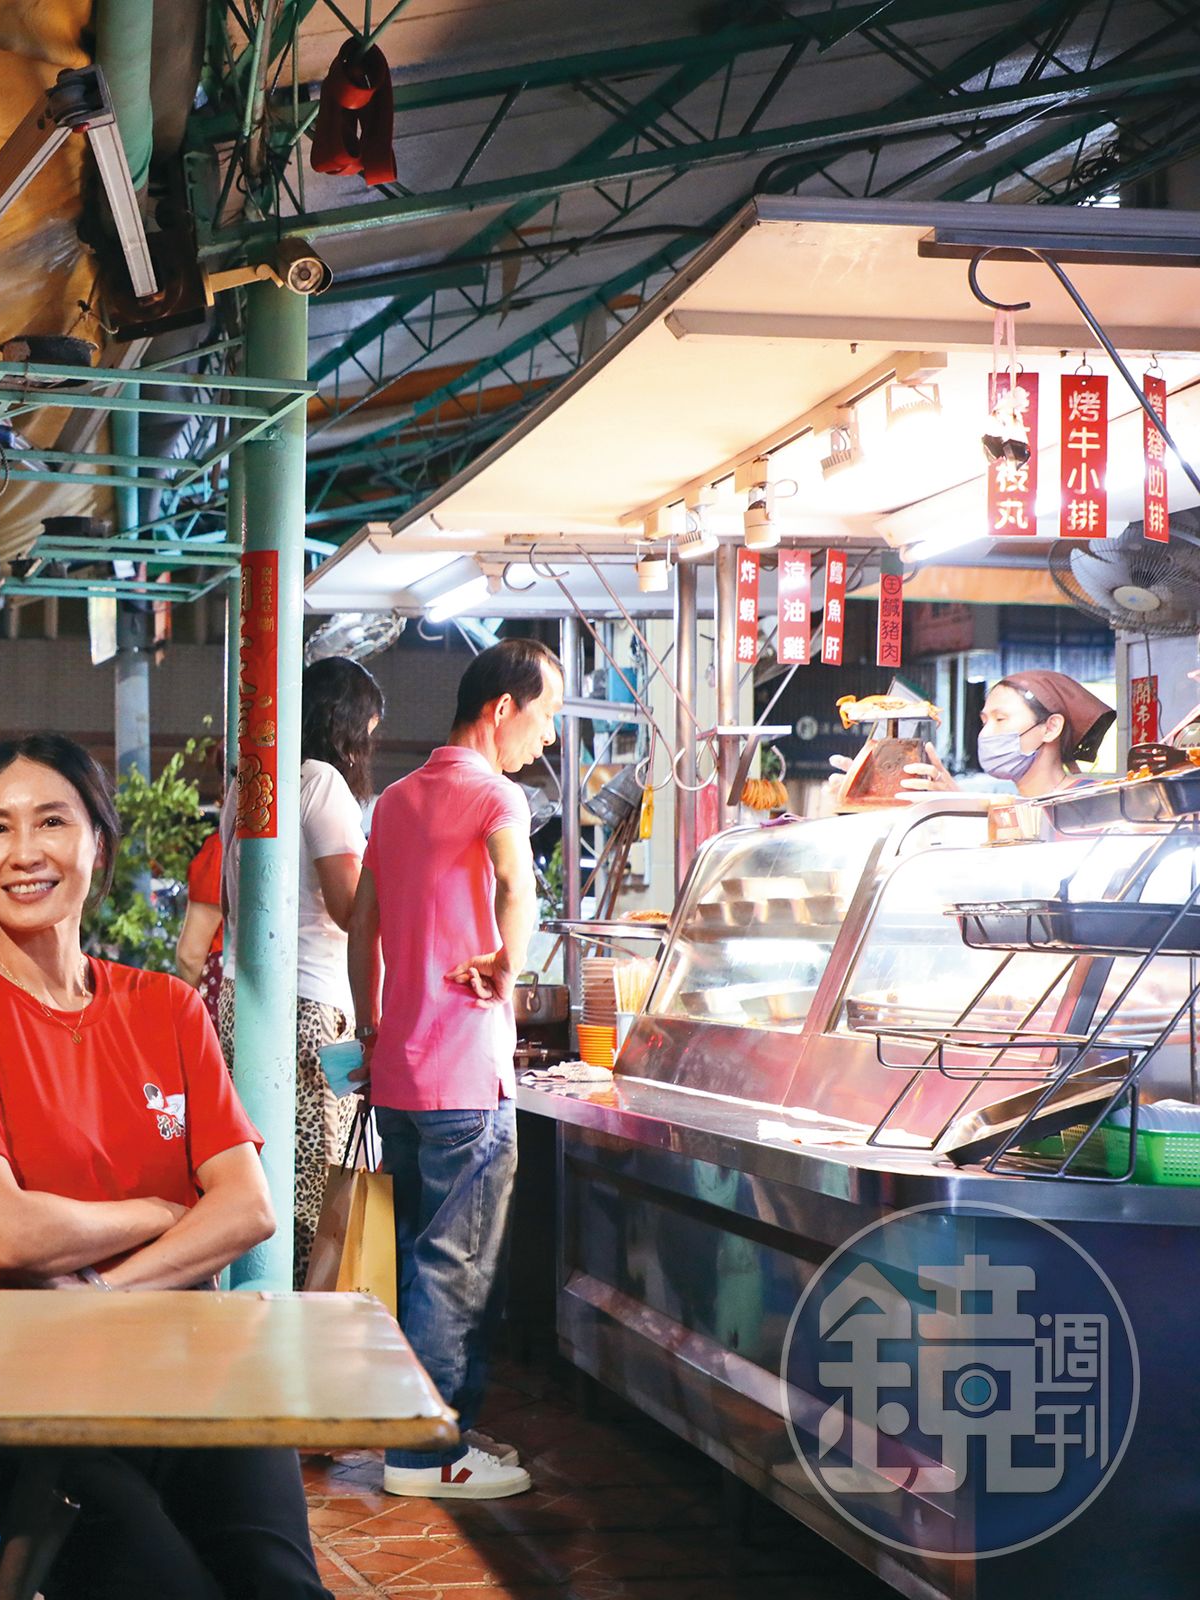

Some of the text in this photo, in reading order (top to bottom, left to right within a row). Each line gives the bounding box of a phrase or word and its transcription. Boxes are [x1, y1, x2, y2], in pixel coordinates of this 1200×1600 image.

[1067, 389, 1101, 532] 烤牛小排
[738, 559, 757, 660] 炸蝦排
